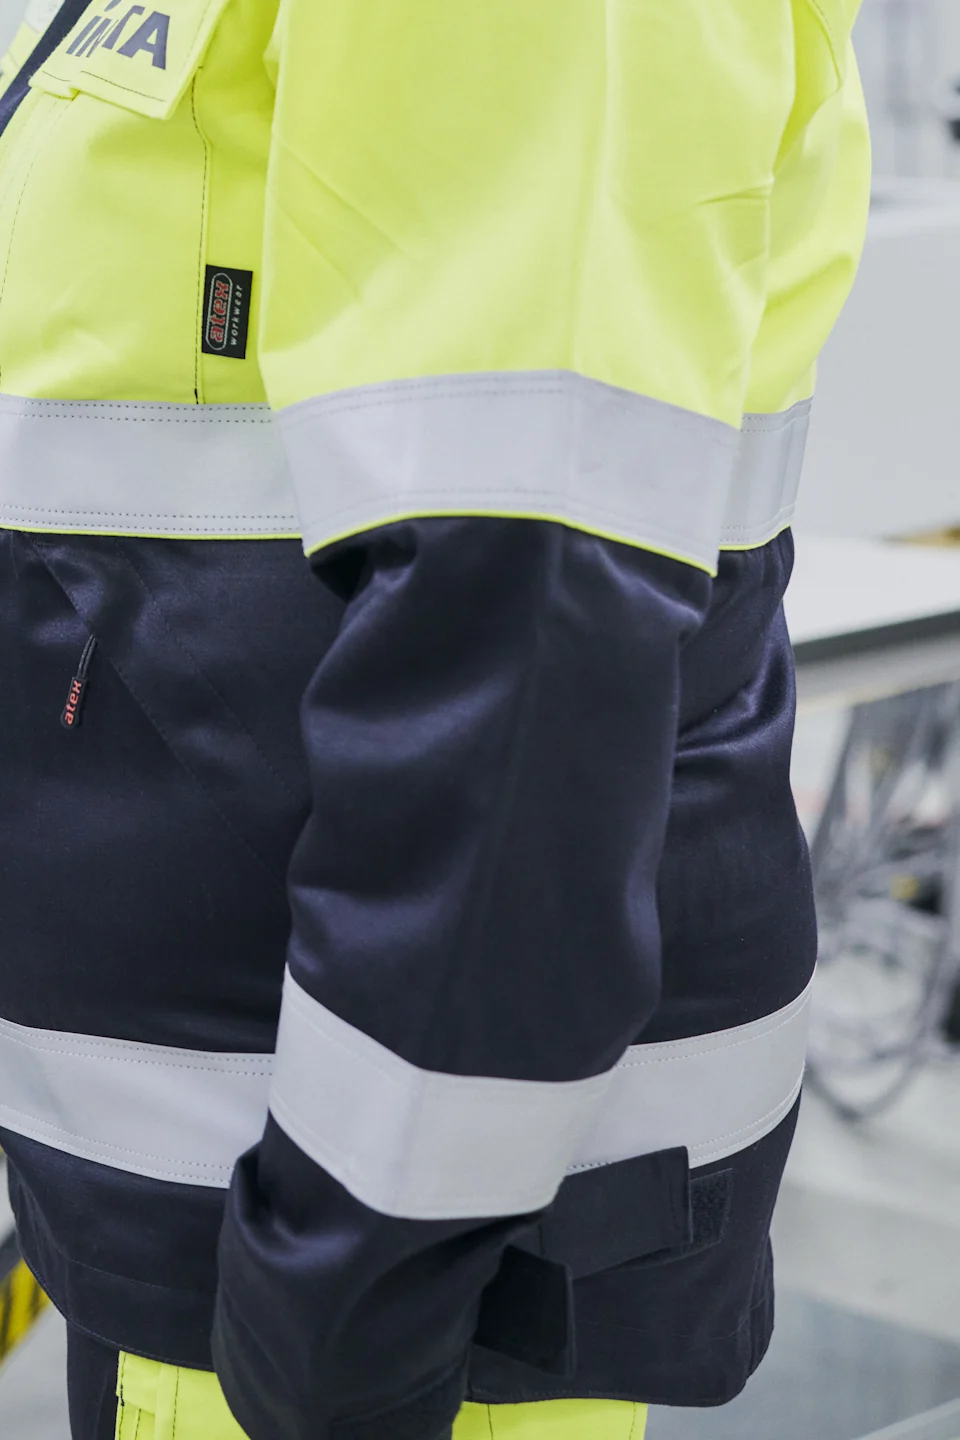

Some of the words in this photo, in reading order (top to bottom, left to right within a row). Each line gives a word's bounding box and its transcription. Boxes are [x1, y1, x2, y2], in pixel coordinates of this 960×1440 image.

[210, 280, 229, 343] atex
[230, 284, 243, 346] workwear
[64, 680, 82, 725] atex
